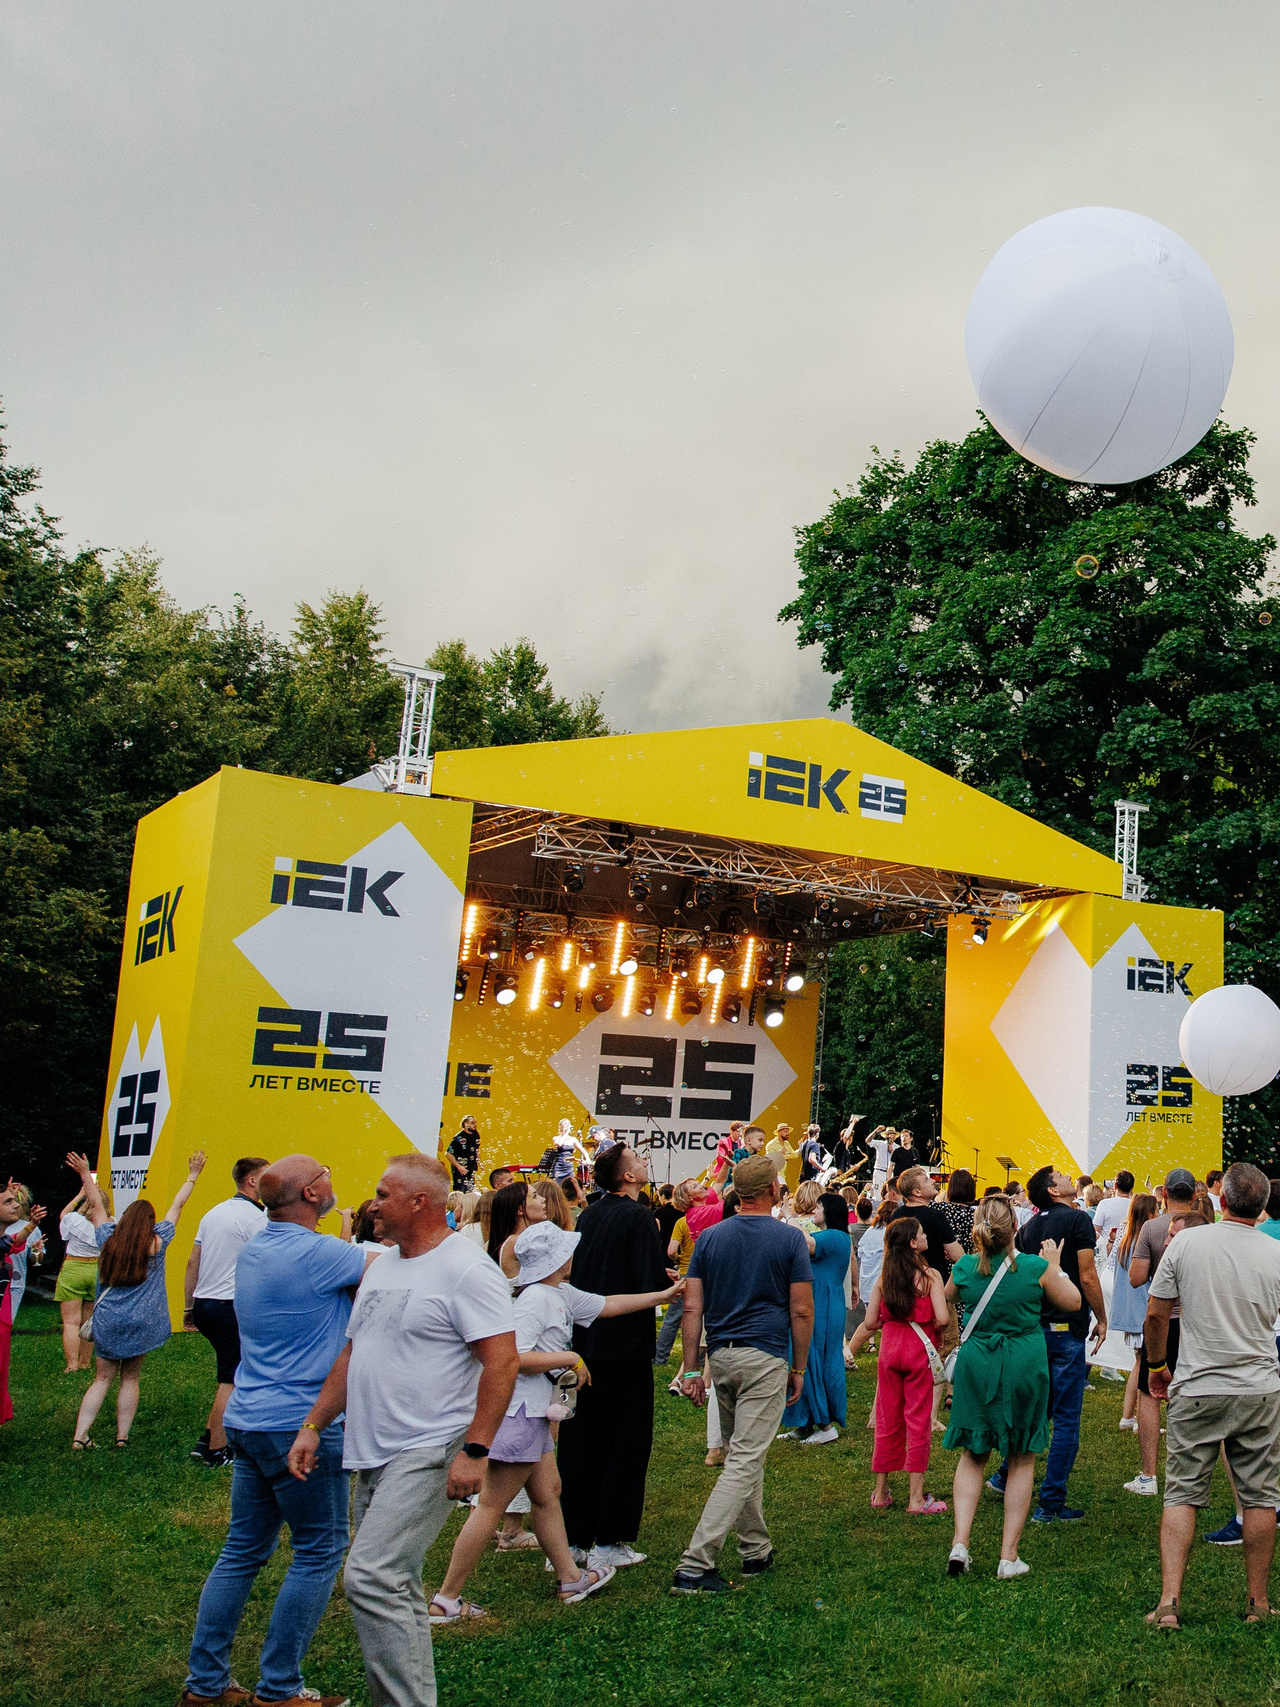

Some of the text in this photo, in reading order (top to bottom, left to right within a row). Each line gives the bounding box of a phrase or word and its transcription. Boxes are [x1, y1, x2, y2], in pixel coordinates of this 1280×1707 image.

[858, 780, 907, 816] 25
[251, 1006, 389, 1072] 25
[249, 1074, 381, 1094] ЛЕТ ВМЕСТЕ
[595, 1033, 757, 1122] 25
[1126, 1063, 1193, 1108] 25
[112, 1070, 160, 1157] 25
[1126, 1111, 1193, 1124] ЛЕТ ВМЕСТЕ
[613, 1128, 645, 1150] ЕТ
[108, 1169, 148, 1190] ЛЕТ ВМЕСТЕ
